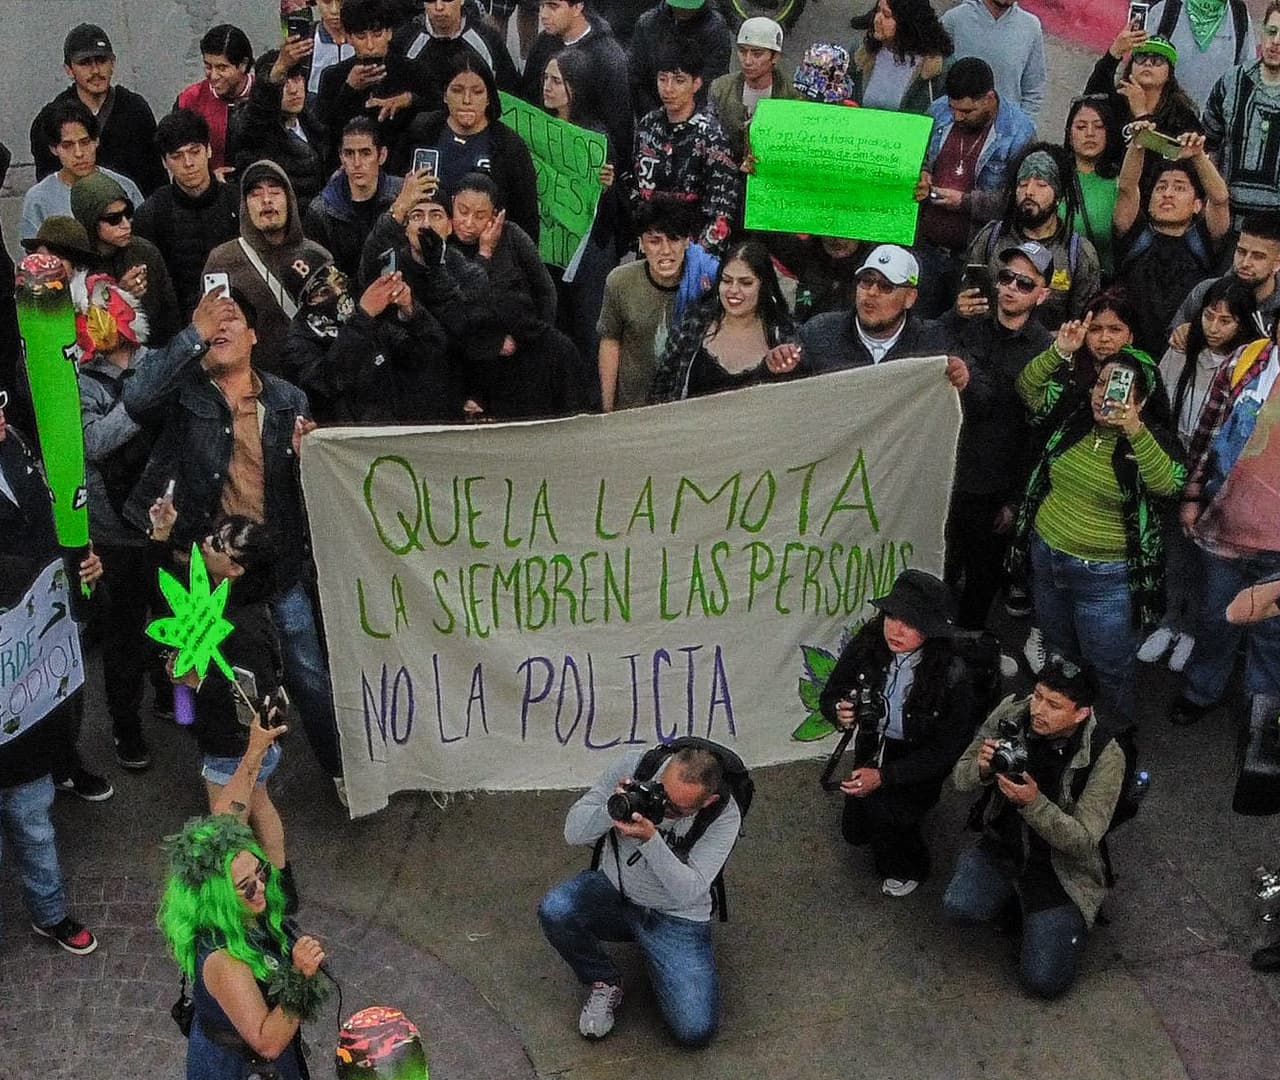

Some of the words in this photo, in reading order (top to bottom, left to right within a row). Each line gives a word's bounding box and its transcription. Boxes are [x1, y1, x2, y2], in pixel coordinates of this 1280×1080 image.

[356, 574, 410, 640] LA
[432, 546, 631, 640] SIEMBREN
[659, 540, 731, 622] LAS
[361, 661, 416, 763] NO
[432, 652, 491, 743] LA
